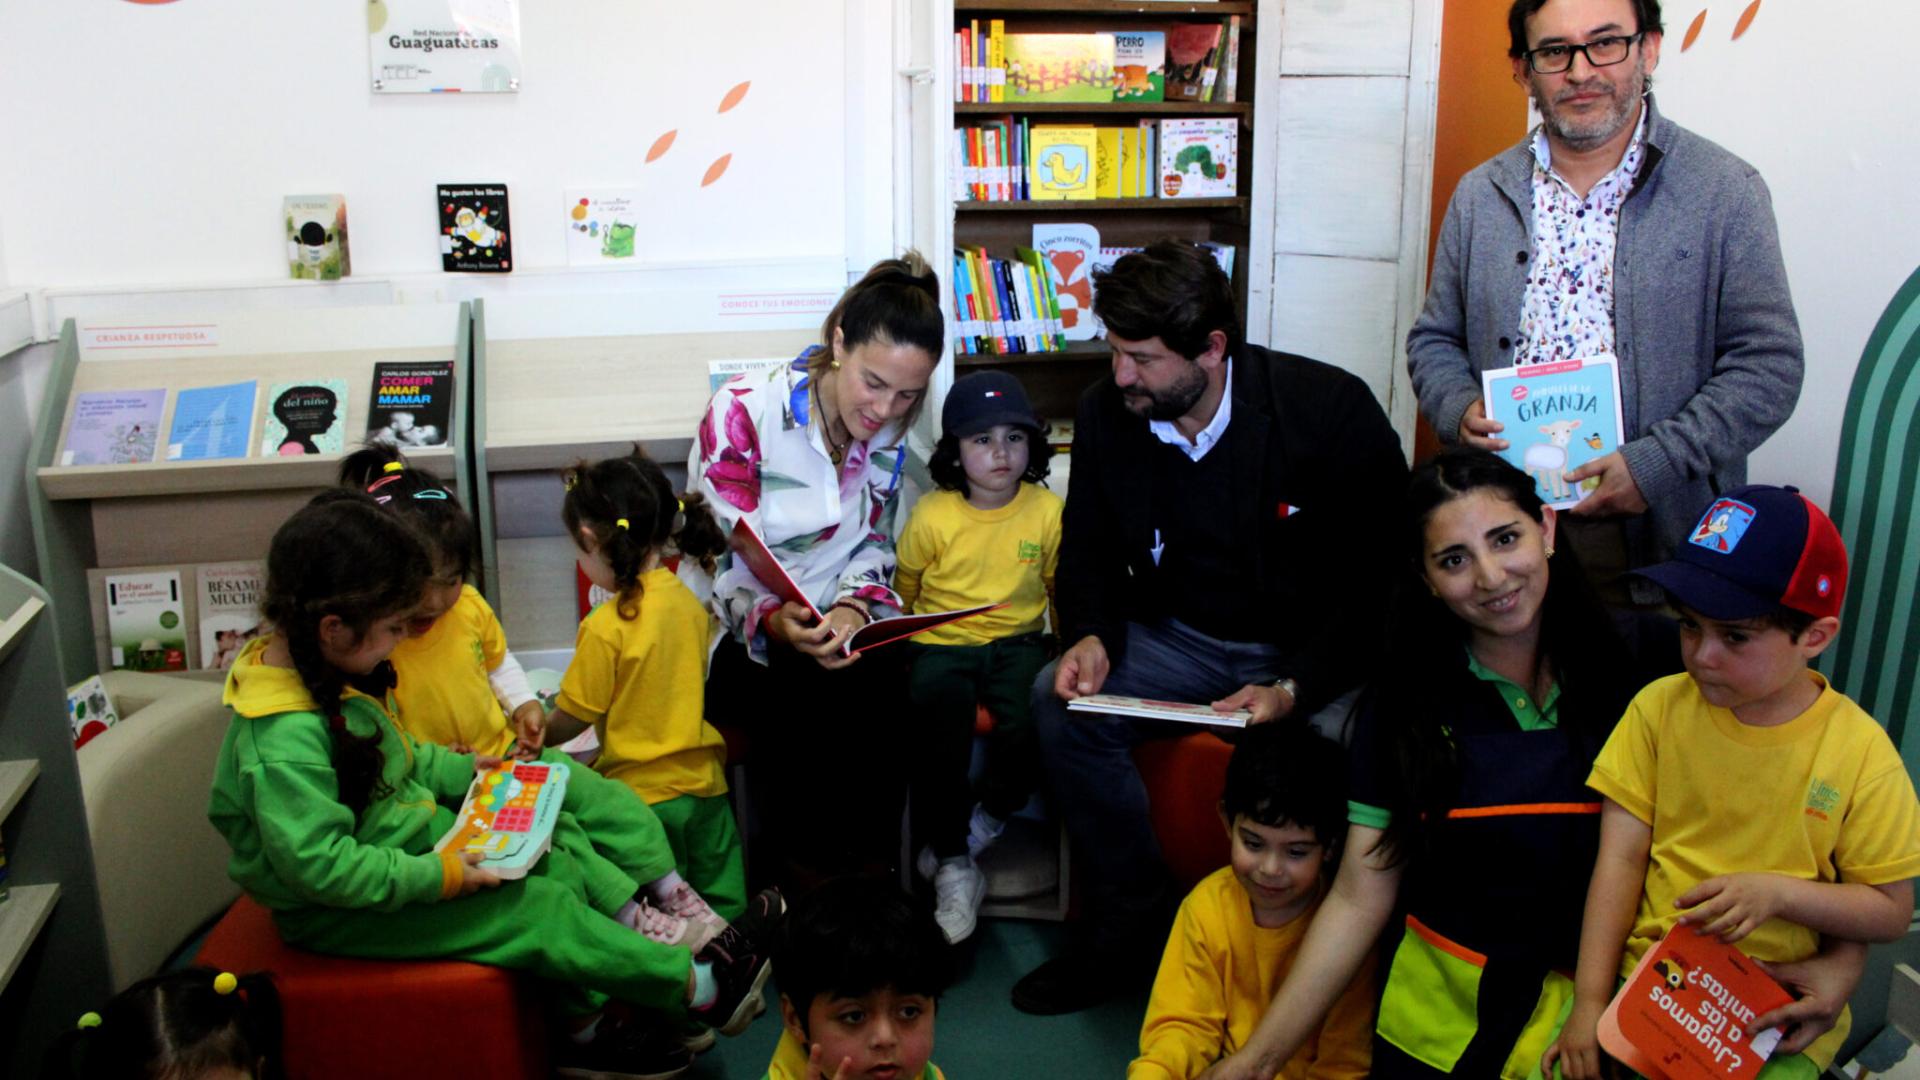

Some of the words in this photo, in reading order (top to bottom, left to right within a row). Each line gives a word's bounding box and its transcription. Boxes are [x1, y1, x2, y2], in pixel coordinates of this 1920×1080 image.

[1116, 37, 1144, 47] PERRO
[452, 190, 473, 198] gustan
[474, 188, 484, 196] los
[485, 188, 505, 196] libros
[96, 334, 140, 343] CRIANZA
[144, 332, 206, 341] RESPETUOSA
[380, 377, 433, 386] COMER
[379, 386, 420, 395] AMAR
[283, 398, 301, 408] del
[303, 397, 329, 407] niño
[378, 395, 432, 404] MAMAR
[1518, 393, 1597, 422] GRANJA
[118, 582, 153, 591] Educar
[1687, 965, 1756, 1025] anitas?
[1698, 1000, 1728, 1034] las
[1649, 985, 1742, 1073] ¿Jugamos
[1727, 1024, 1742, 1042] a
